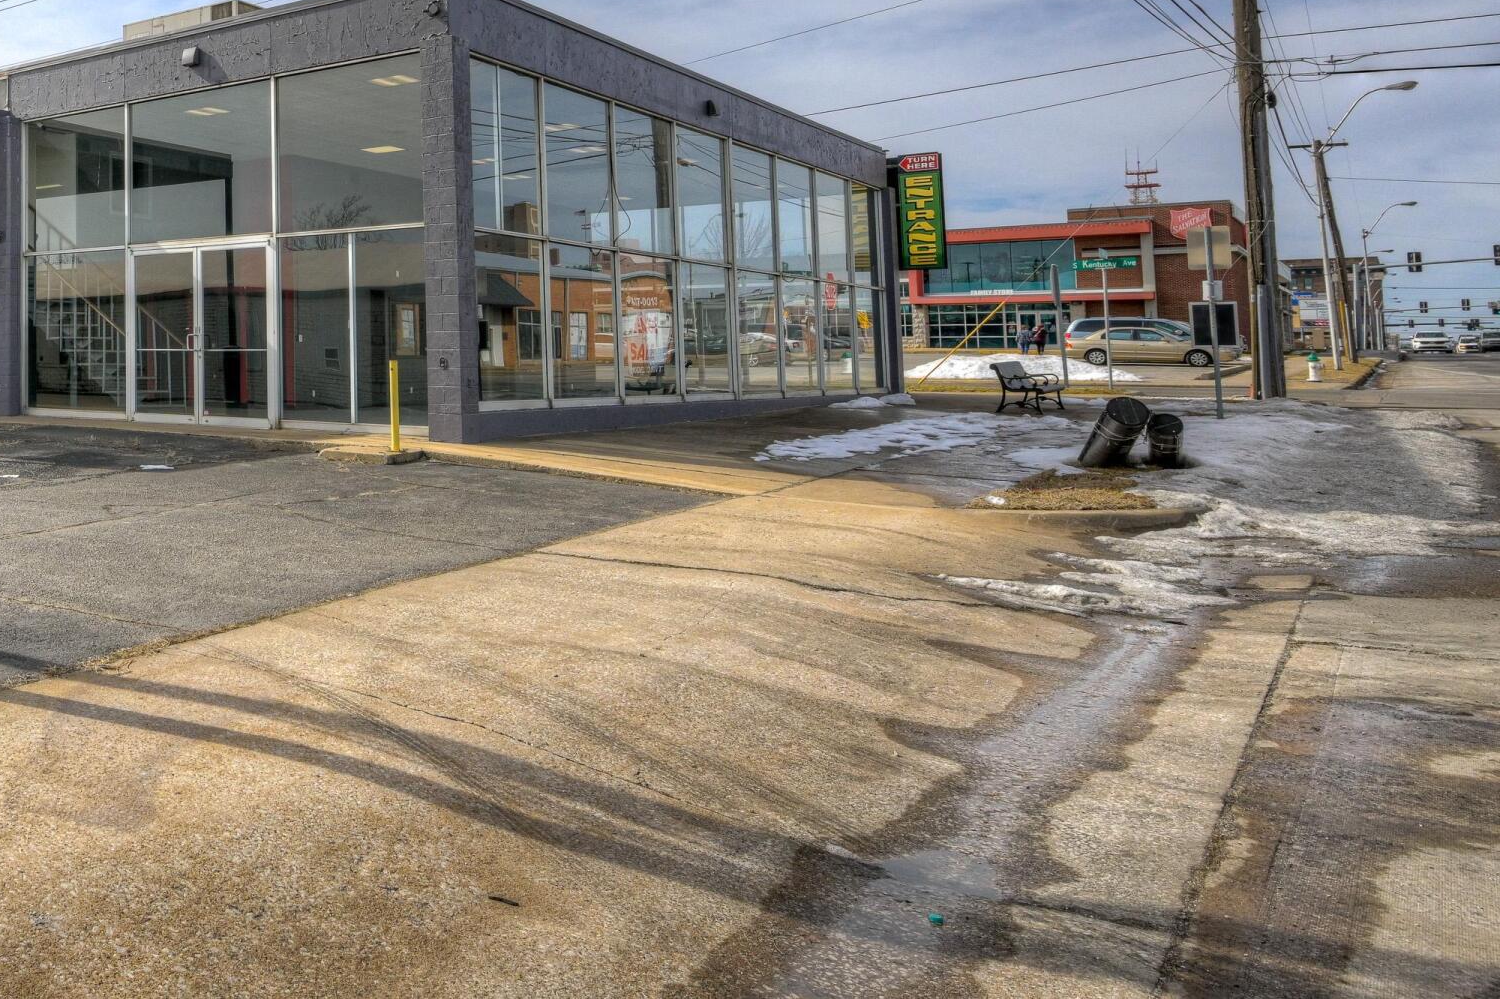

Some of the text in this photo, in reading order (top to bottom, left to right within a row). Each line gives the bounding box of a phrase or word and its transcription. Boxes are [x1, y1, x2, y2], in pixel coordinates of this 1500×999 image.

[905, 175, 938, 266] ENTRANCE
[1172, 211, 1207, 233] SALVATION
[1179, 212, 1193, 221] THE
[1082, 260, 1116, 269] Kentucky
[1123, 259, 1137, 267] Ave
